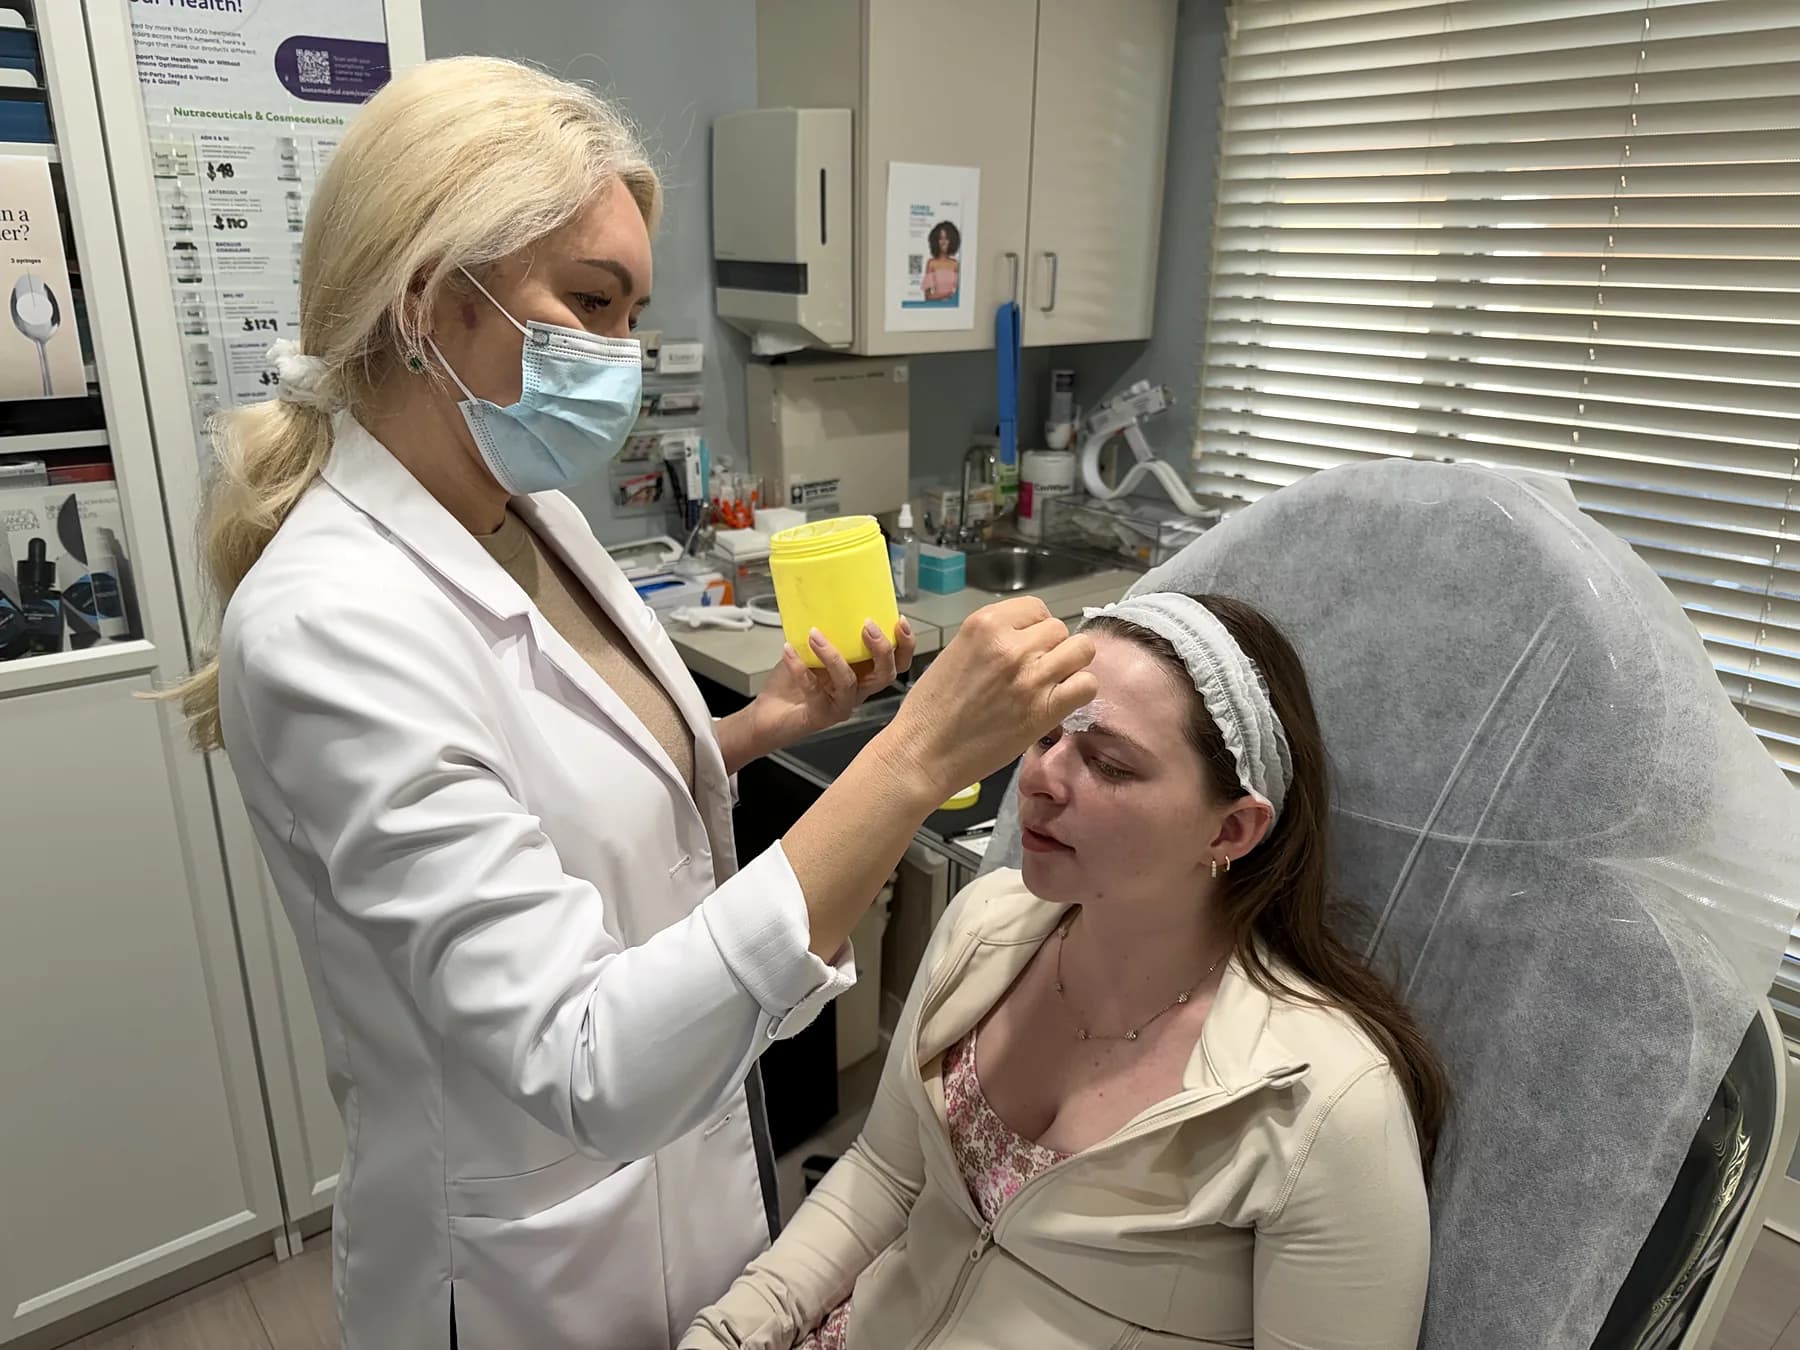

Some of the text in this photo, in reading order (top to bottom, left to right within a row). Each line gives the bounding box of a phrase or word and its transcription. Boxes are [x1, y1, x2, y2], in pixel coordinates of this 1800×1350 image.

[145, 24, 153, 32] by
[201, 45, 229, 53] products
[158, 79, 180, 87] Quality
[174, 107, 253, 121] Nutraceuticals
[266, 113, 344, 125] Cosmeceuticals
[18, 209, 29, 222] a
[242, 318, 278, 332] $129
